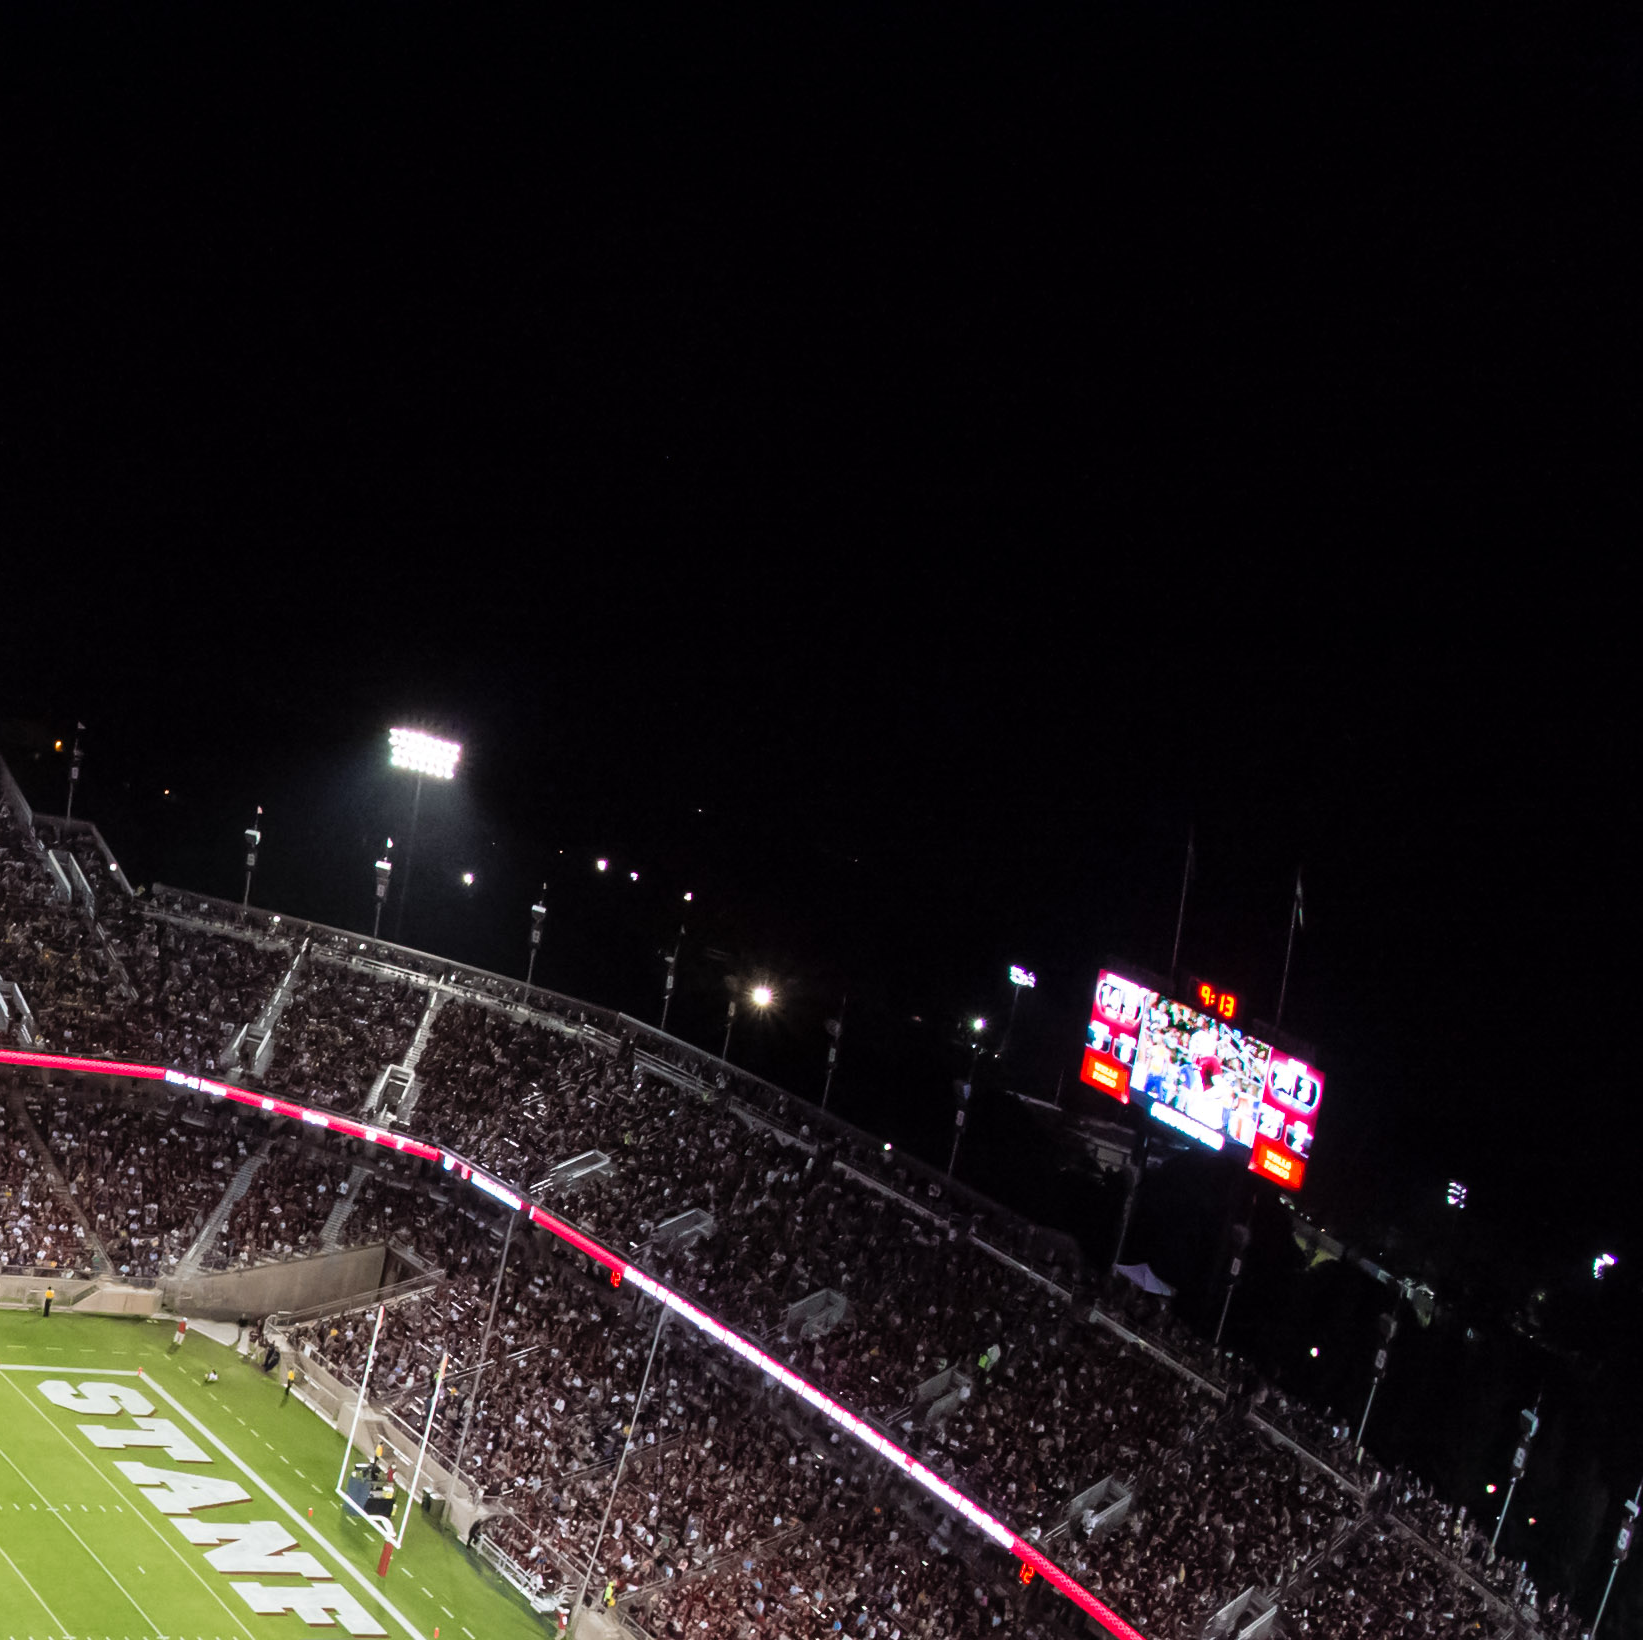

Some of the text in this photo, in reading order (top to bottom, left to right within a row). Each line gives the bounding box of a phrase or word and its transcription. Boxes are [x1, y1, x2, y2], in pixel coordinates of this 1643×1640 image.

[1200, 985, 1236, 1018] 9:13
[1094, 1062, 1119, 1080] WELLS
[1266, 1149, 1292, 1170] WELLS
[1019, 1561, 1035, 1585] 12
